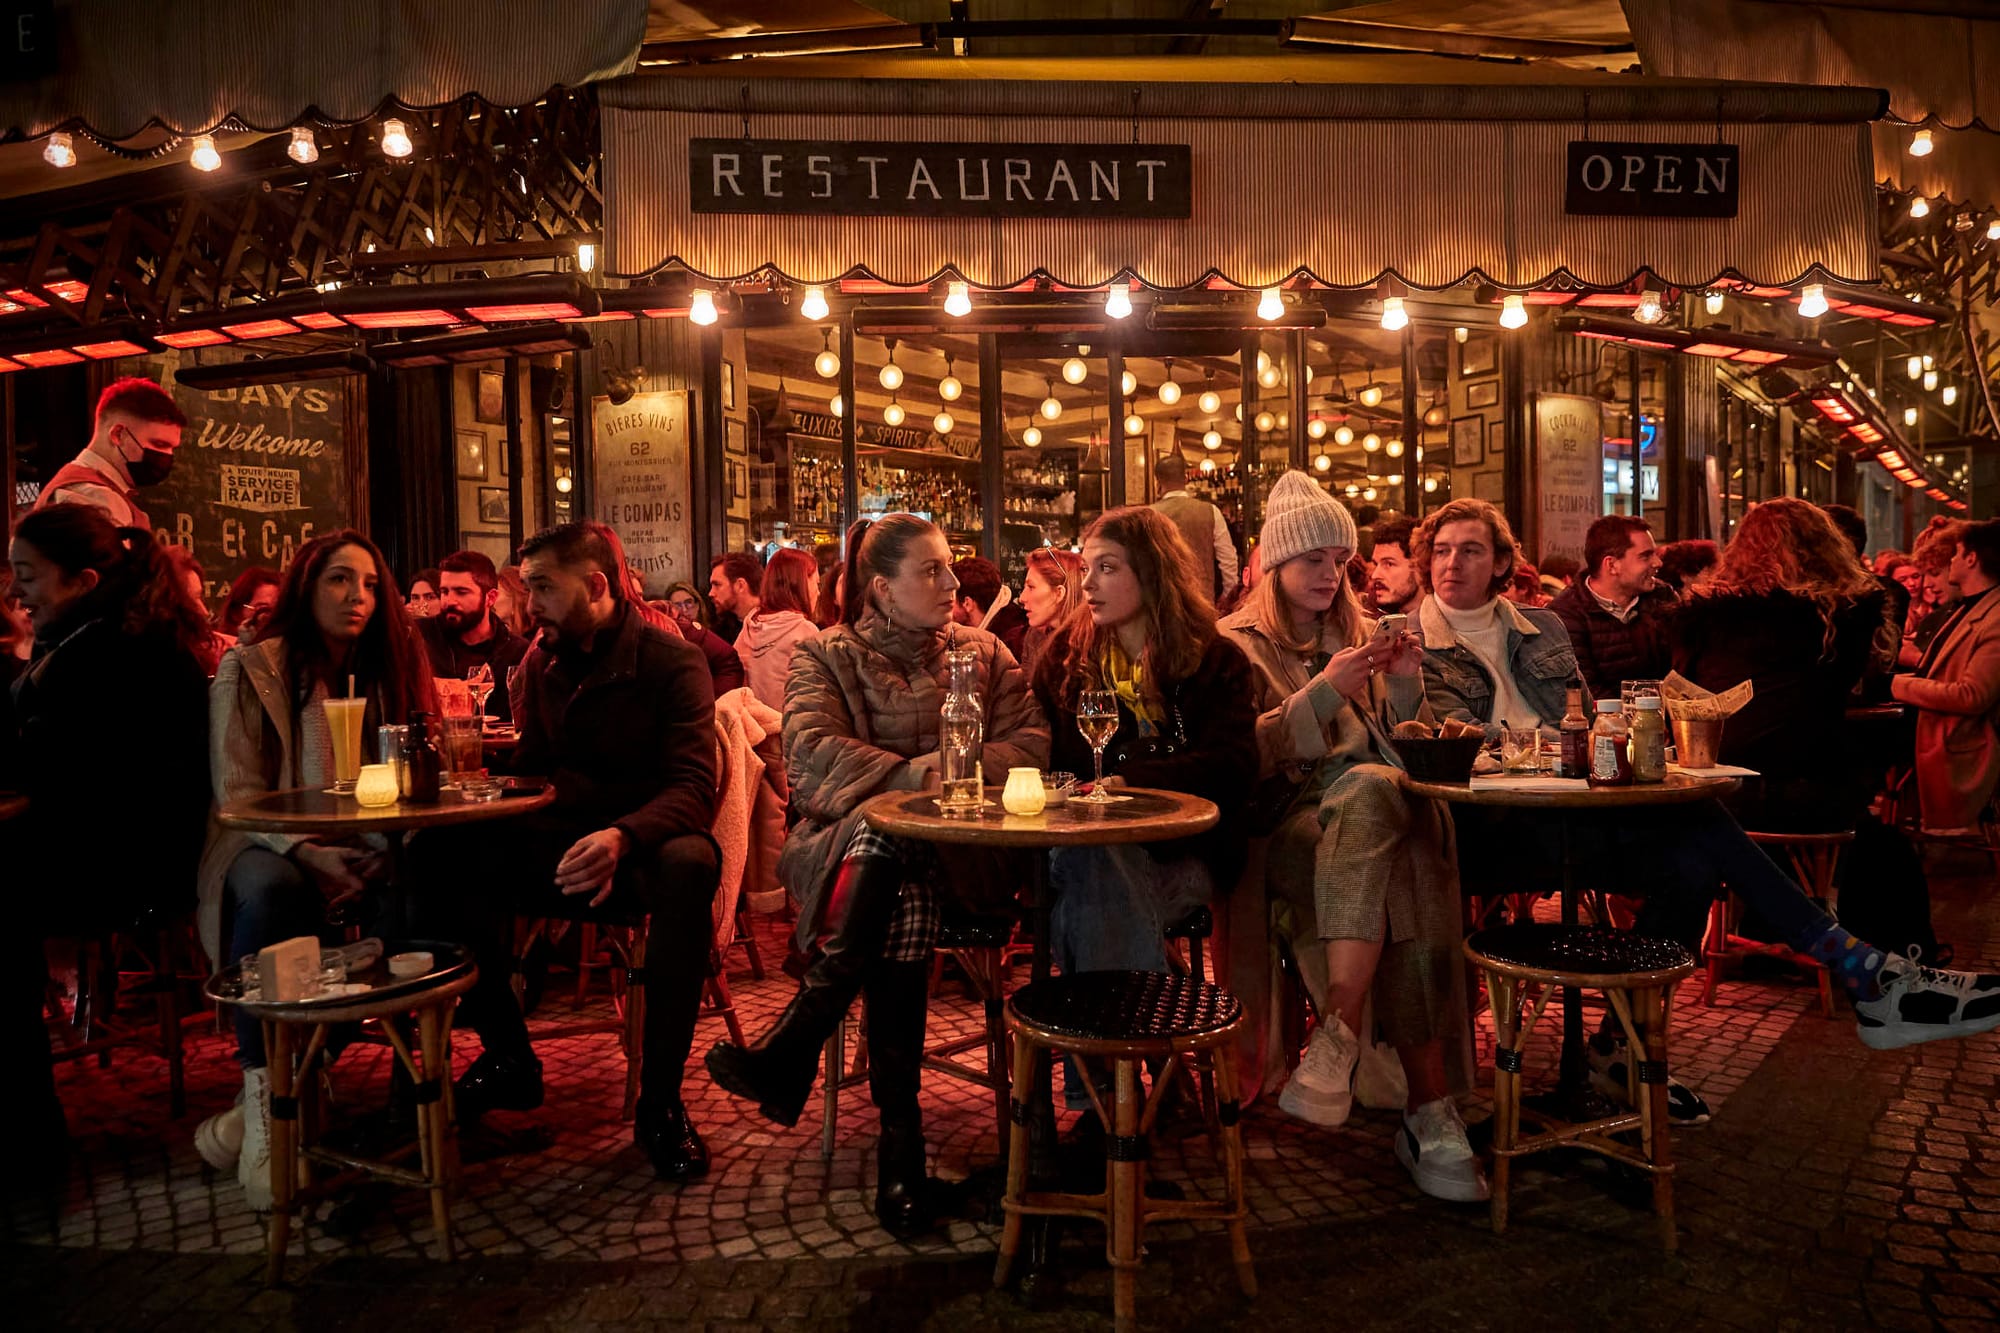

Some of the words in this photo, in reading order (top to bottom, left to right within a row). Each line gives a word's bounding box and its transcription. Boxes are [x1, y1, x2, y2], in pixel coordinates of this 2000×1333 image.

[711, 152, 1167, 202] RESTAURANT
[1581, 154, 1732, 195] OPEN
[649, 412, 675, 432] VINS
[793, 413, 843, 438] ELIXIRS
[198, 418, 326, 458] Welcome
[630, 441, 650, 456] 62
[875, 426, 922, 449] SPIRITS
[1563, 438, 1577, 452] 62
[227, 475, 294, 491] SERVICE
[228, 487, 294, 505] RAPIDE
[624, 502, 681, 523] COMPAS
[222, 518, 248, 559] Et
[623, 551, 673, 574] PERITIFS
